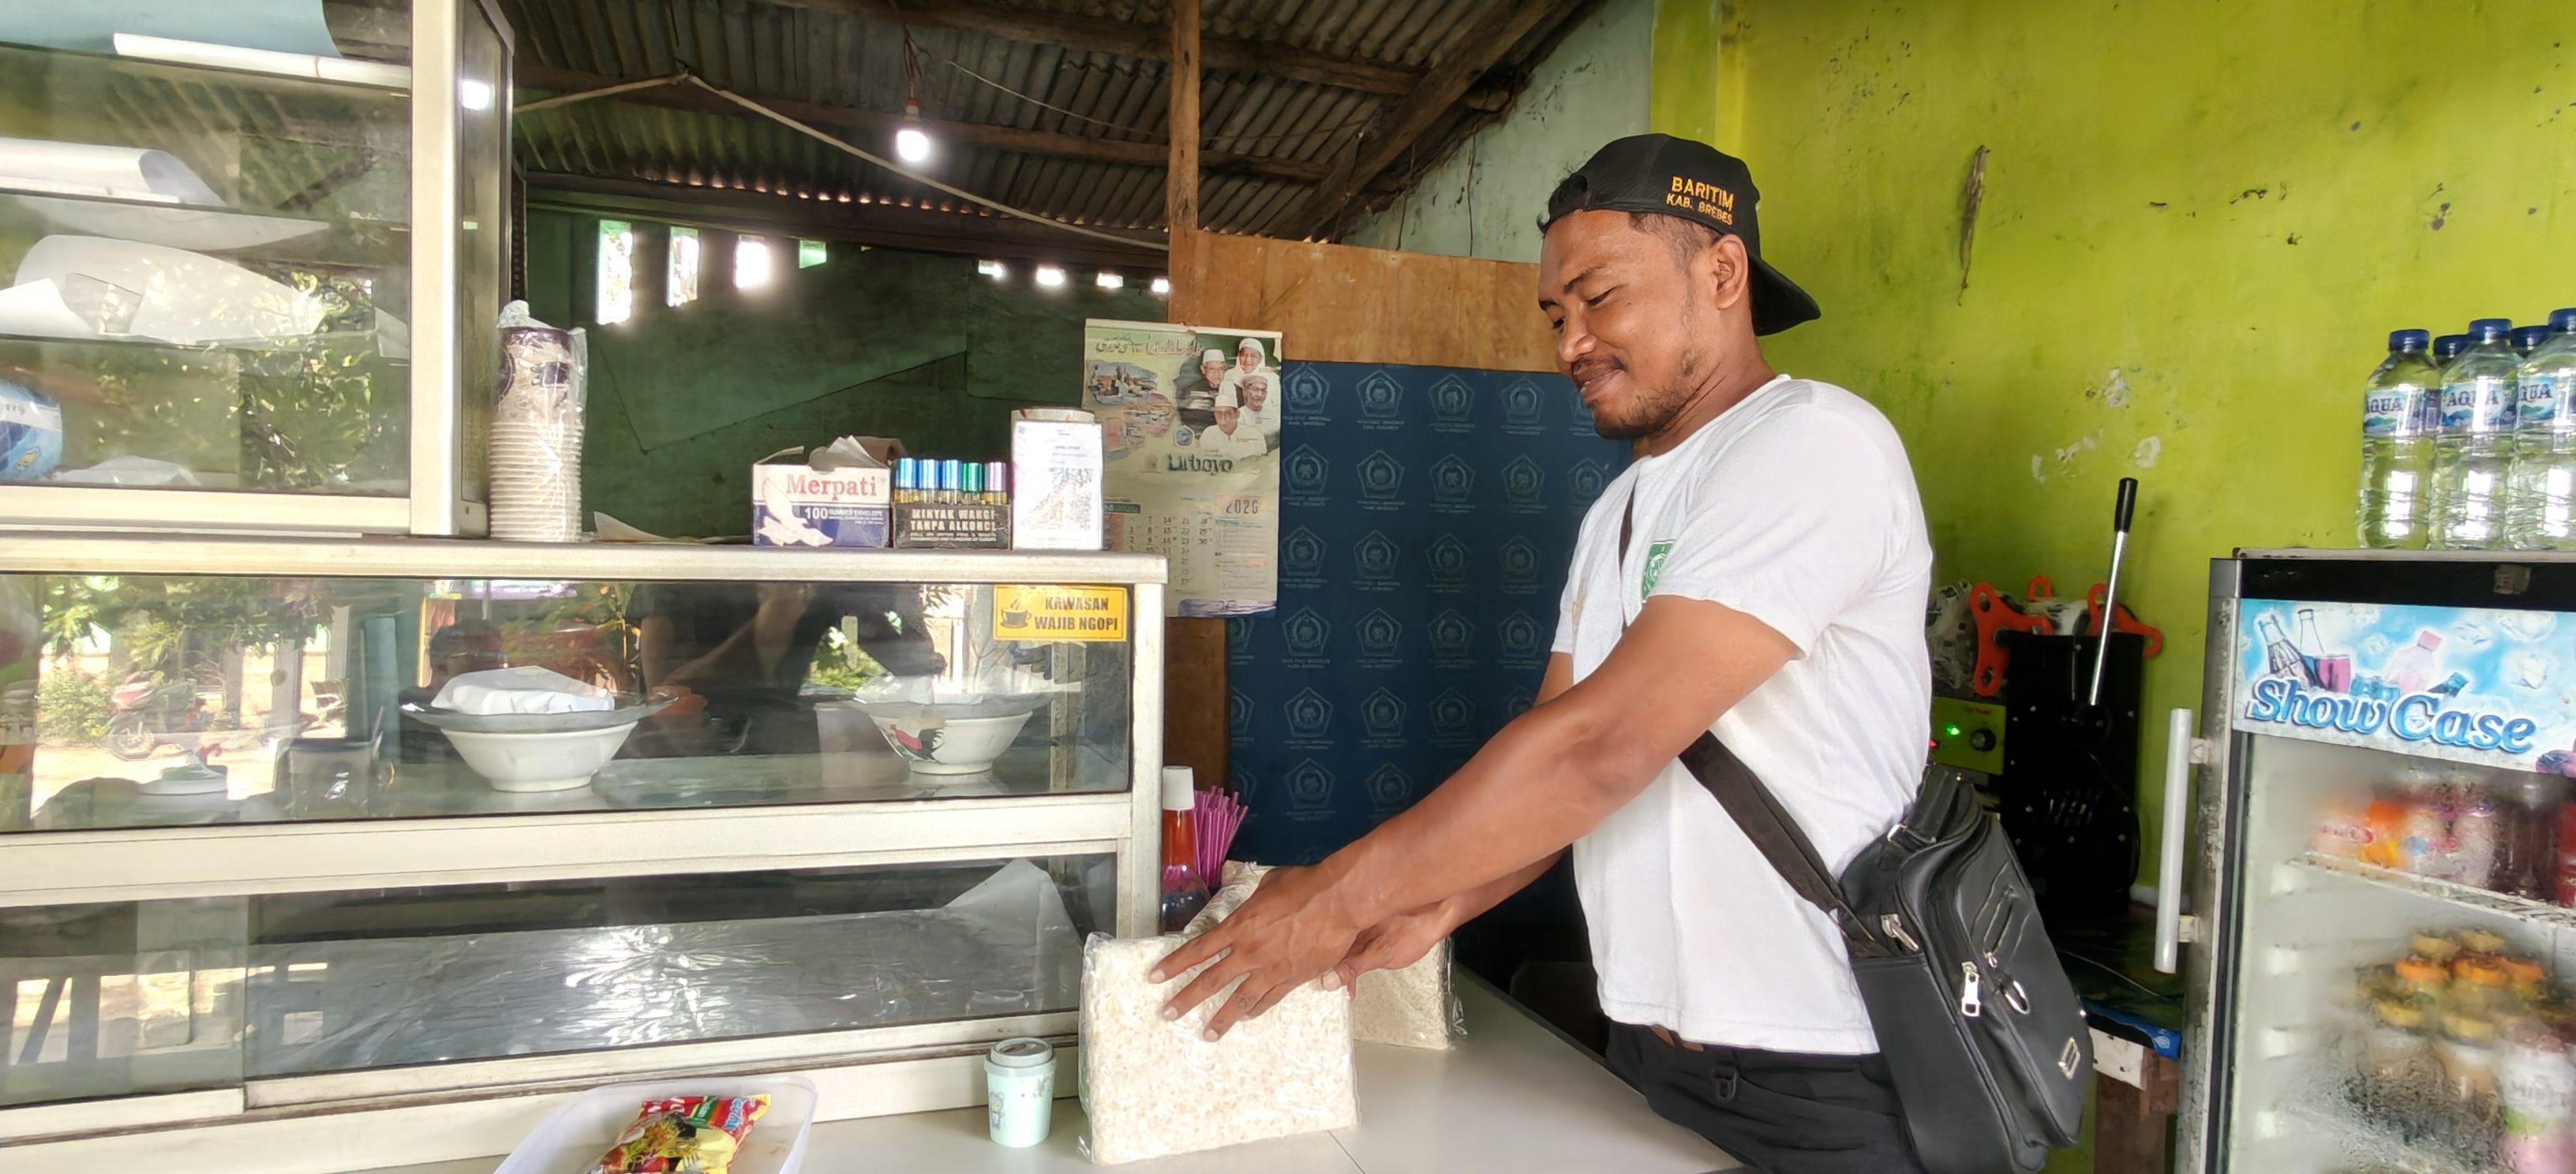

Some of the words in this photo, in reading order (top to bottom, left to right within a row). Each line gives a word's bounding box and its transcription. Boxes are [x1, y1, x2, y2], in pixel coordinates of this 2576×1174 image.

[1671, 176, 1735, 212] BARITIM
[1666, 193, 1694, 211] KAB.
[1698, 201, 1733, 226] BREBES
[2518, 383, 2554, 402] QUA
[786, 474, 878, 500] Merpati
[804, 507, 828, 520] 100
[1226, 499, 1259, 514] 2026
[912, 509, 956, 519] MINYAK
[910, 521, 945, 531] TANPA
[1045, 597, 1109, 611] KAWASAN
[1034, 617, 1076, 630] WAJIB
[1079, 618, 1118, 631] NGOPI
